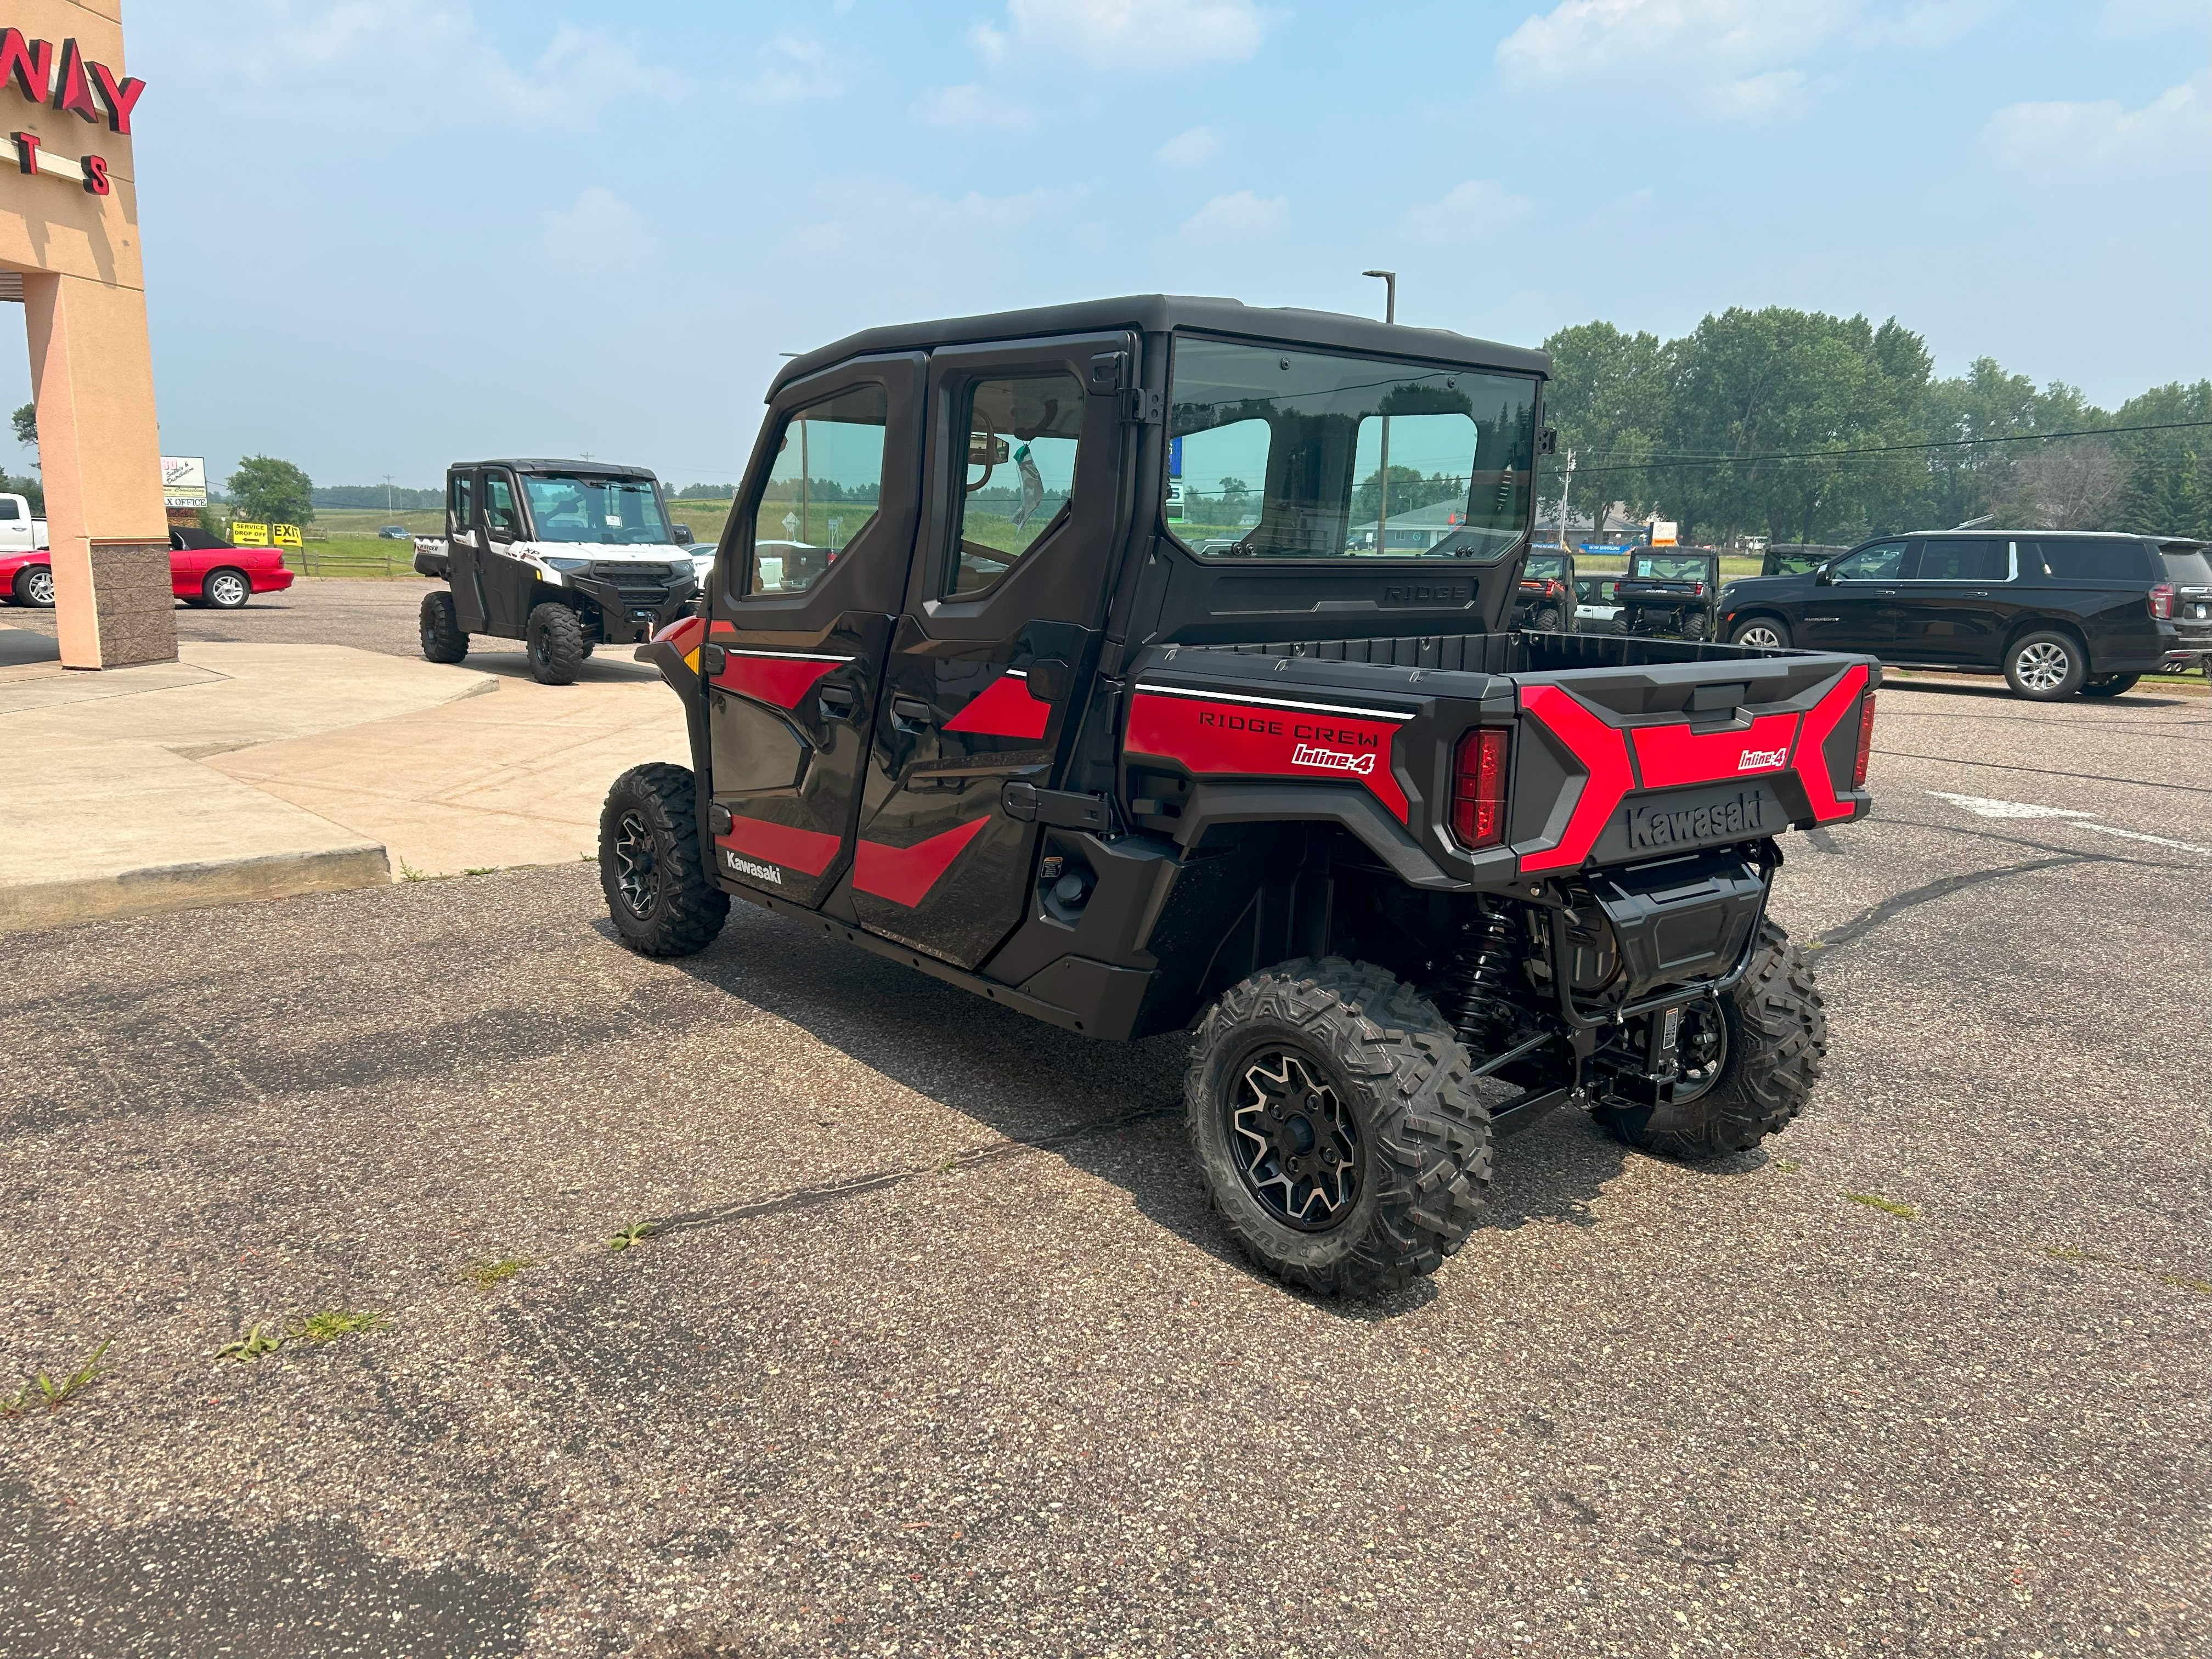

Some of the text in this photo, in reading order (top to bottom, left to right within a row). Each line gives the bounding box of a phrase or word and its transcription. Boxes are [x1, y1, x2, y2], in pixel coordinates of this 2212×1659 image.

[274, 525, 300, 538] EXIT
[1384, 586, 1468, 601] RIDGE
[1198, 712, 1379, 748] RIDGE CREW
[1291, 743, 1376, 775] Inline-4
[1737, 747, 1787, 770] Inline-4
[1627, 790, 1765, 849] Kawasaki
[726, 850, 782, 885] Kawasaki
[1227, 1197, 1293, 1255] DURO
